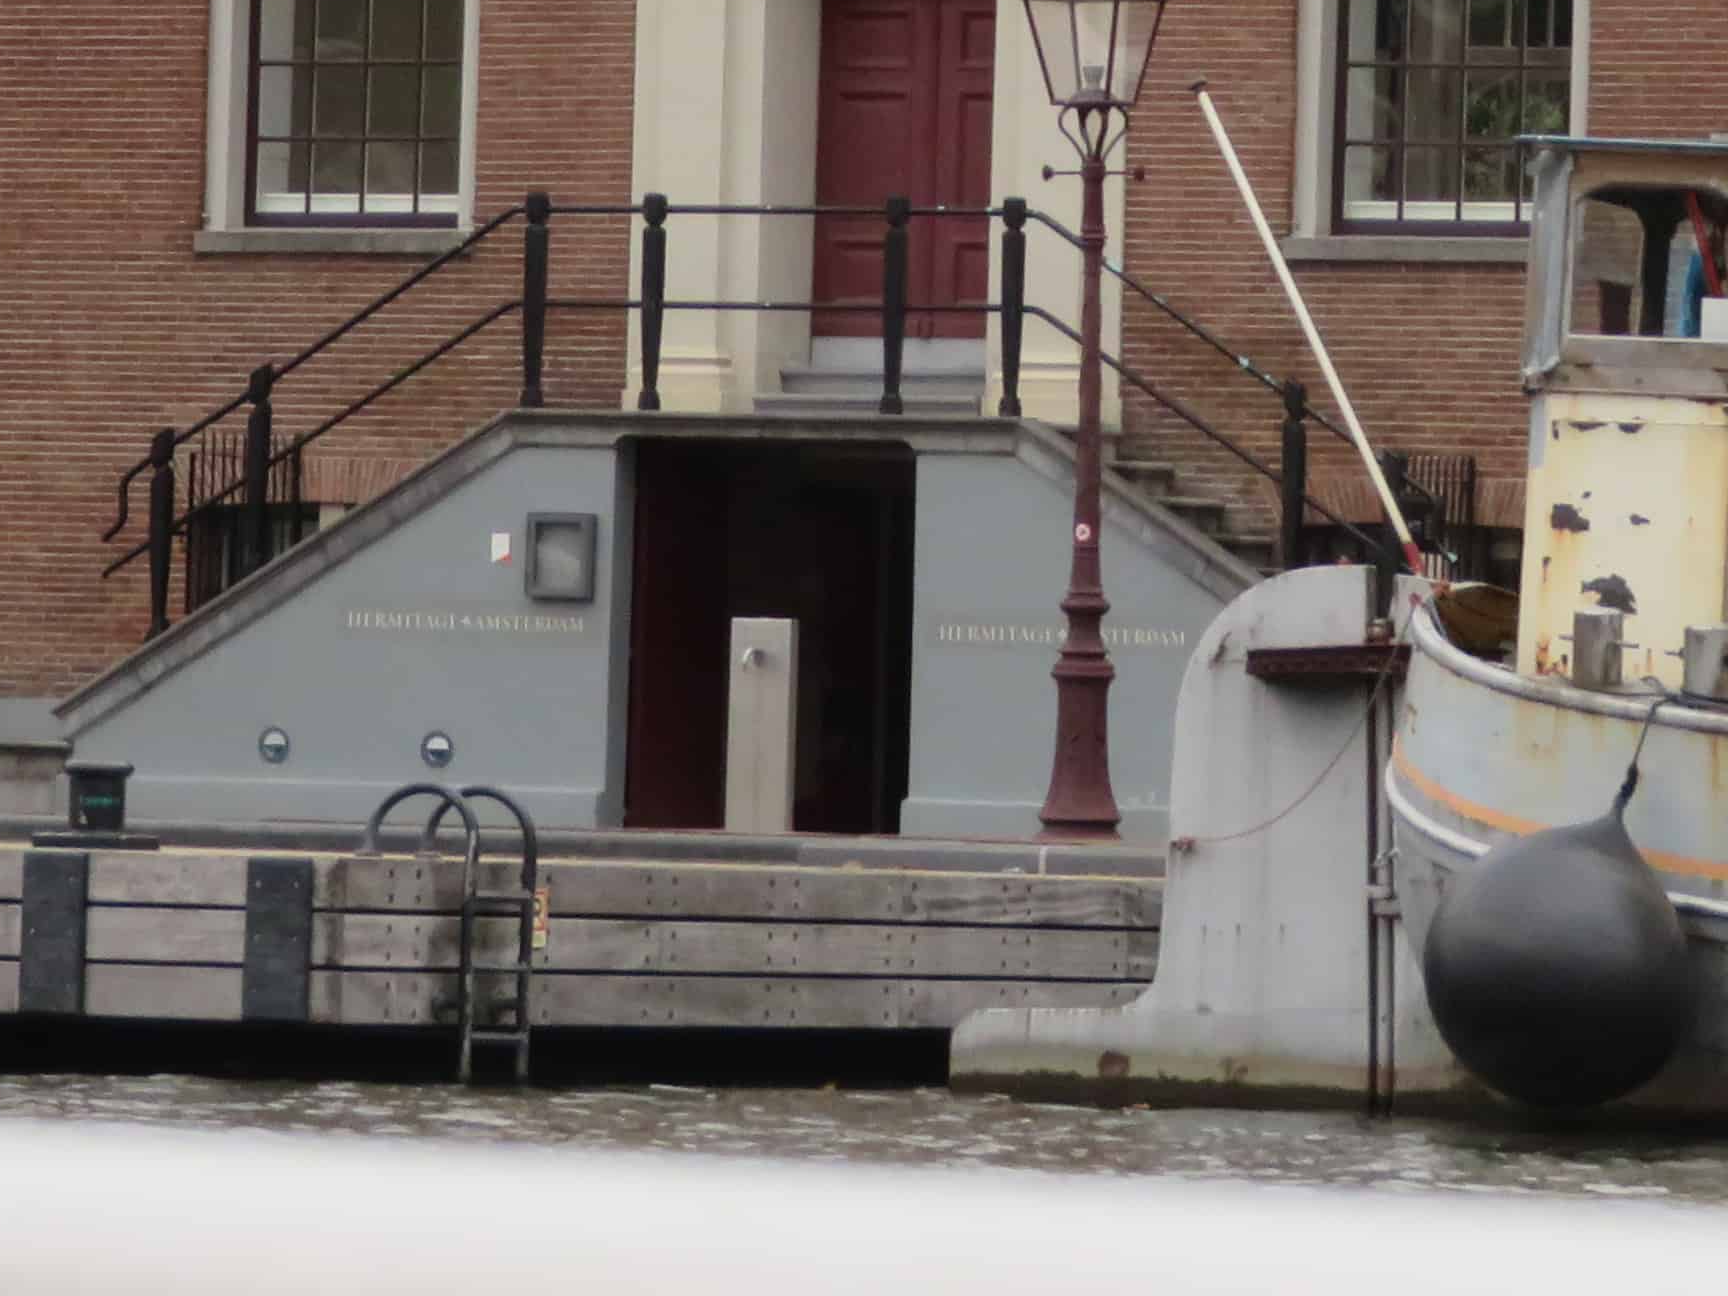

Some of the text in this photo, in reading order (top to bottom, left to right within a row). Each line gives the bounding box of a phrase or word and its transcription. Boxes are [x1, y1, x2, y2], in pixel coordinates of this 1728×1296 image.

[347, 610, 585, 633] HERMITAGE AMSTERDAM
[937, 622, 1185, 647] HERMITAGE STERDAM
